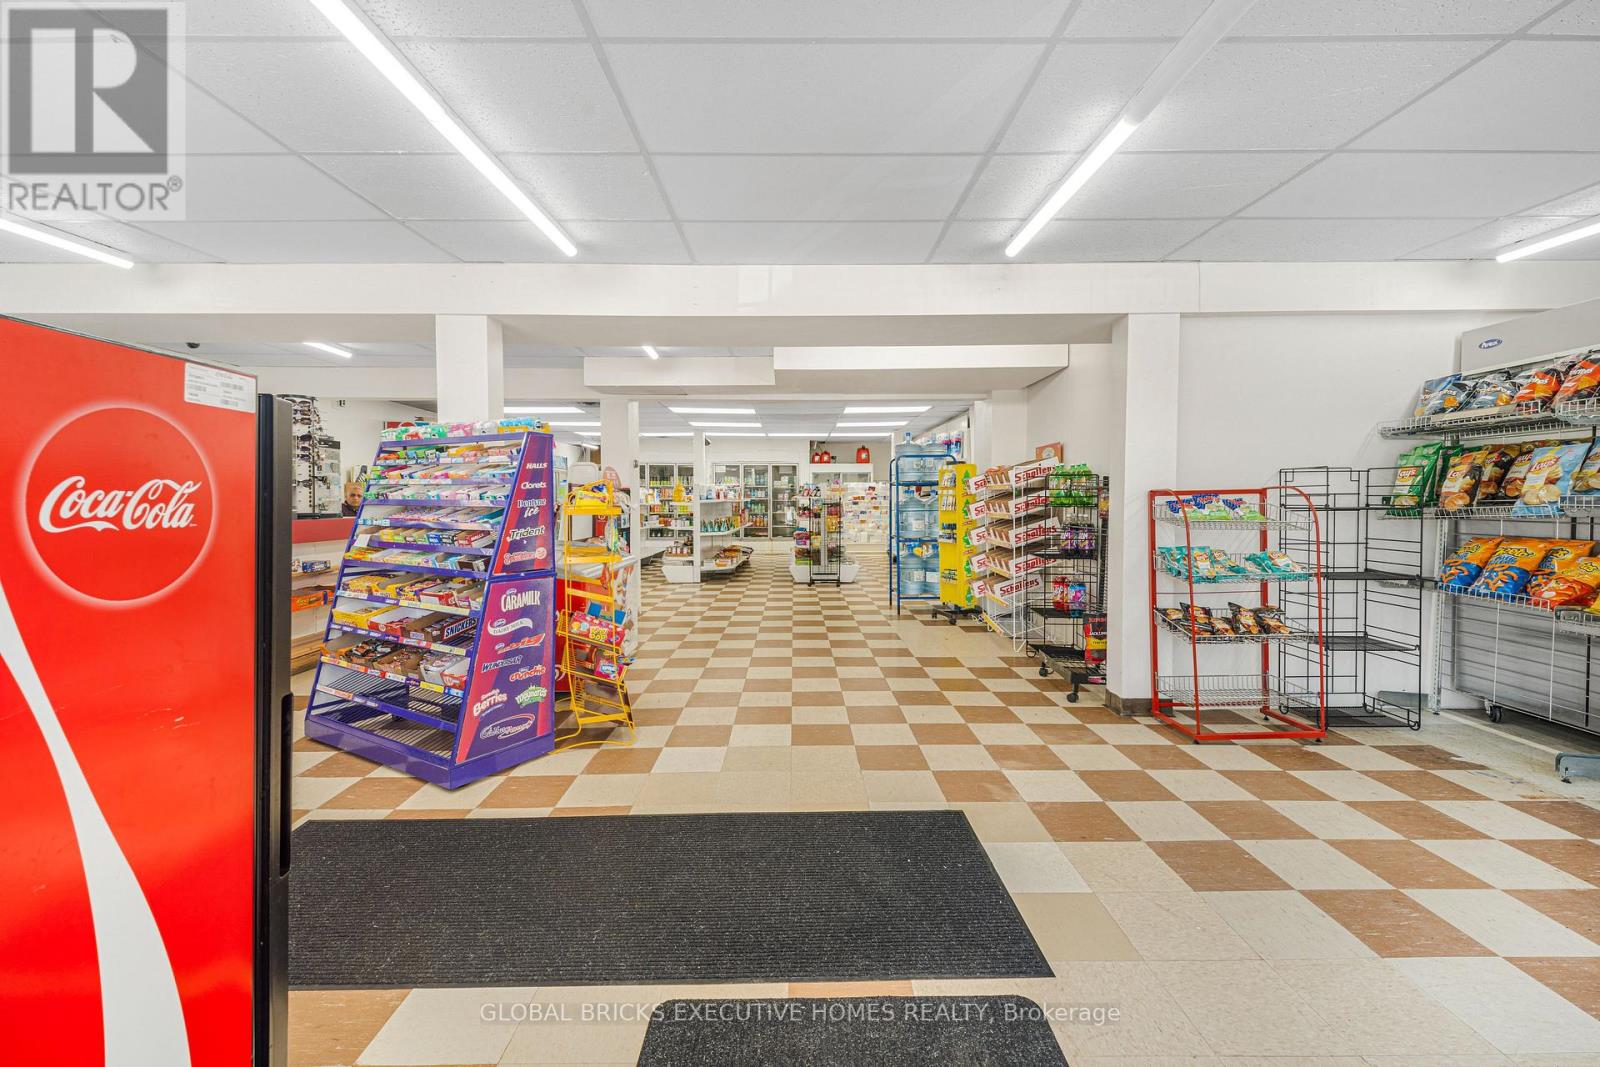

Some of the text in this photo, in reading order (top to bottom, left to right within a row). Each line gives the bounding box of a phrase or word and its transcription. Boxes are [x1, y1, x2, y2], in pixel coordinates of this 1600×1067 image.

[521, 481, 547, 489] Clorets
[39, 475, 202, 533] Coca-Cola
[506, 525, 545, 541] Trident
[501, 590, 541, 612] CARAMILK
[446, 617, 478, 638] SNICKERS
